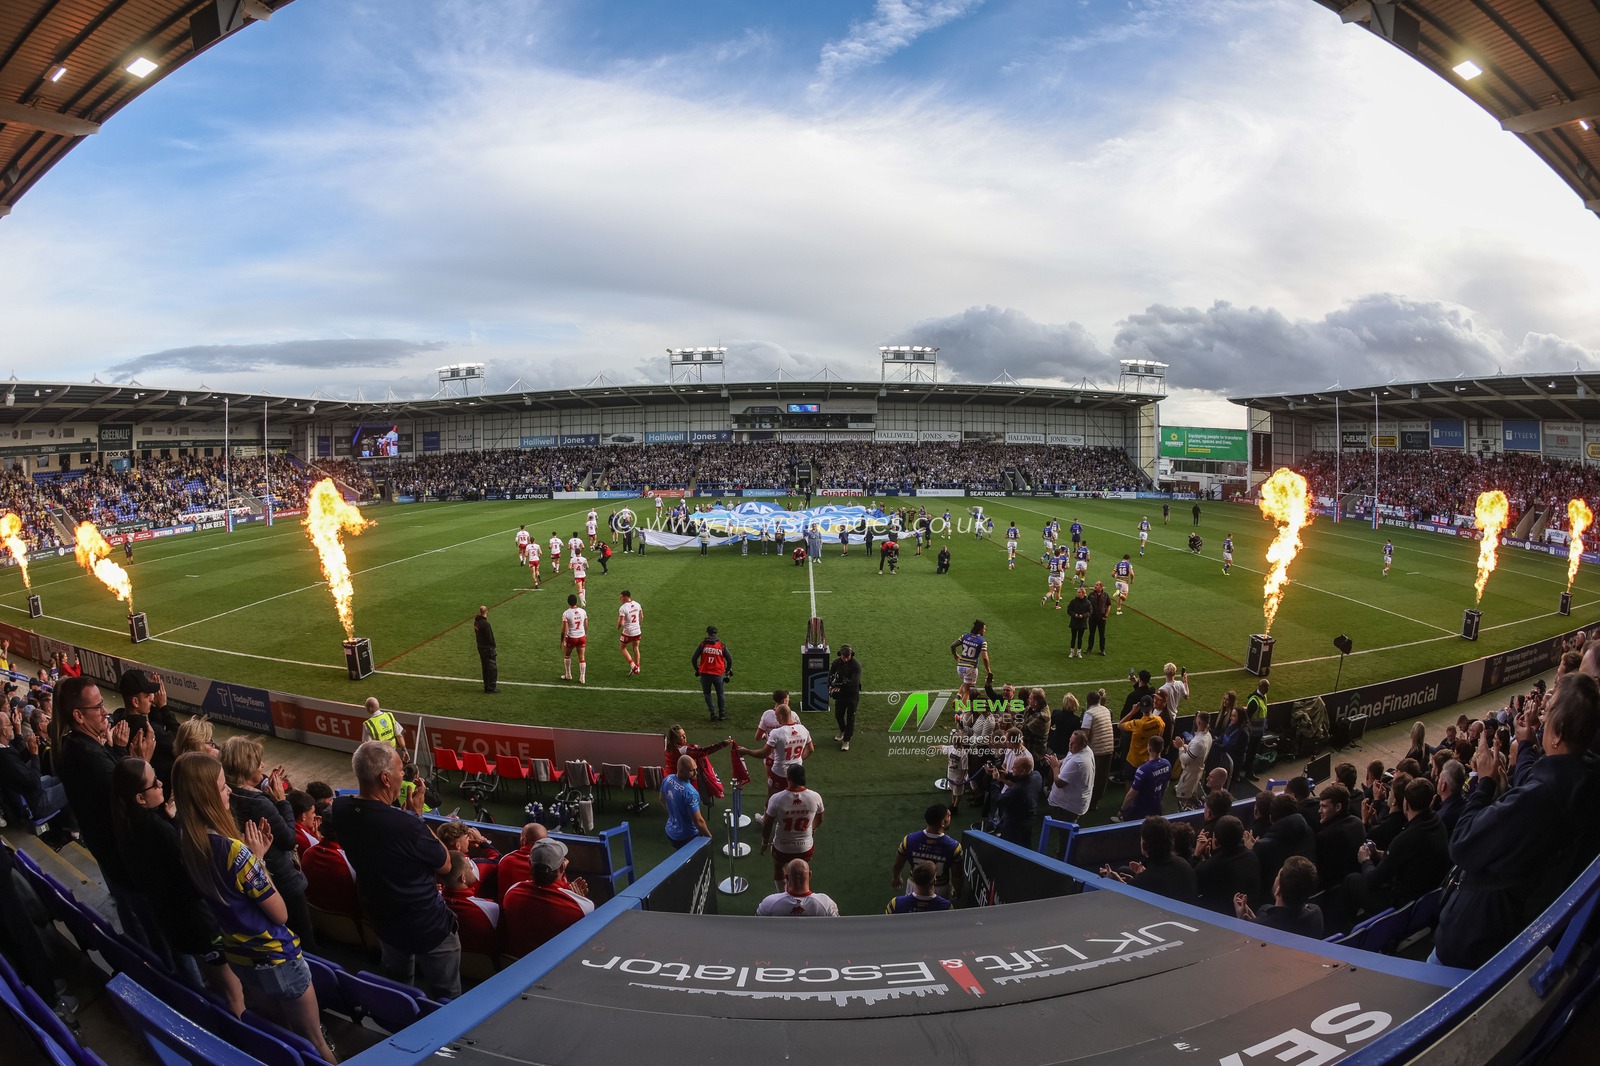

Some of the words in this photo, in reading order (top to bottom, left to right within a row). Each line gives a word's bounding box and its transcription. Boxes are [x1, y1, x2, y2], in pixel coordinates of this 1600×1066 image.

[523, 438, 555, 446] Halliwell
[175, 526, 194, 536] BETFRED
[575, 622, 581, 630] 7
[632, 615, 637, 623] 2
[962, 647, 976, 658] 20
[80, 650, 118, 684] DAVIES
[172, 677, 183, 685] too
[232, 693, 264, 708] TodayTeam
[1336, 683, 1438, 723] HomeFinancial
[315, 715, 351, 736] GET
[456, 736, 530, 760] ZONE
[785, 745, 803, 760] 19
[1152, 766, 1170, 777] WATER
[666, 776, 685, 792] WATER
[782, 818, 809, 832] 10
[1111, 921, 1200, 953] UK
[975, 942, 1088, 973] Lift
[581, 955, 935, 990] Escalator
